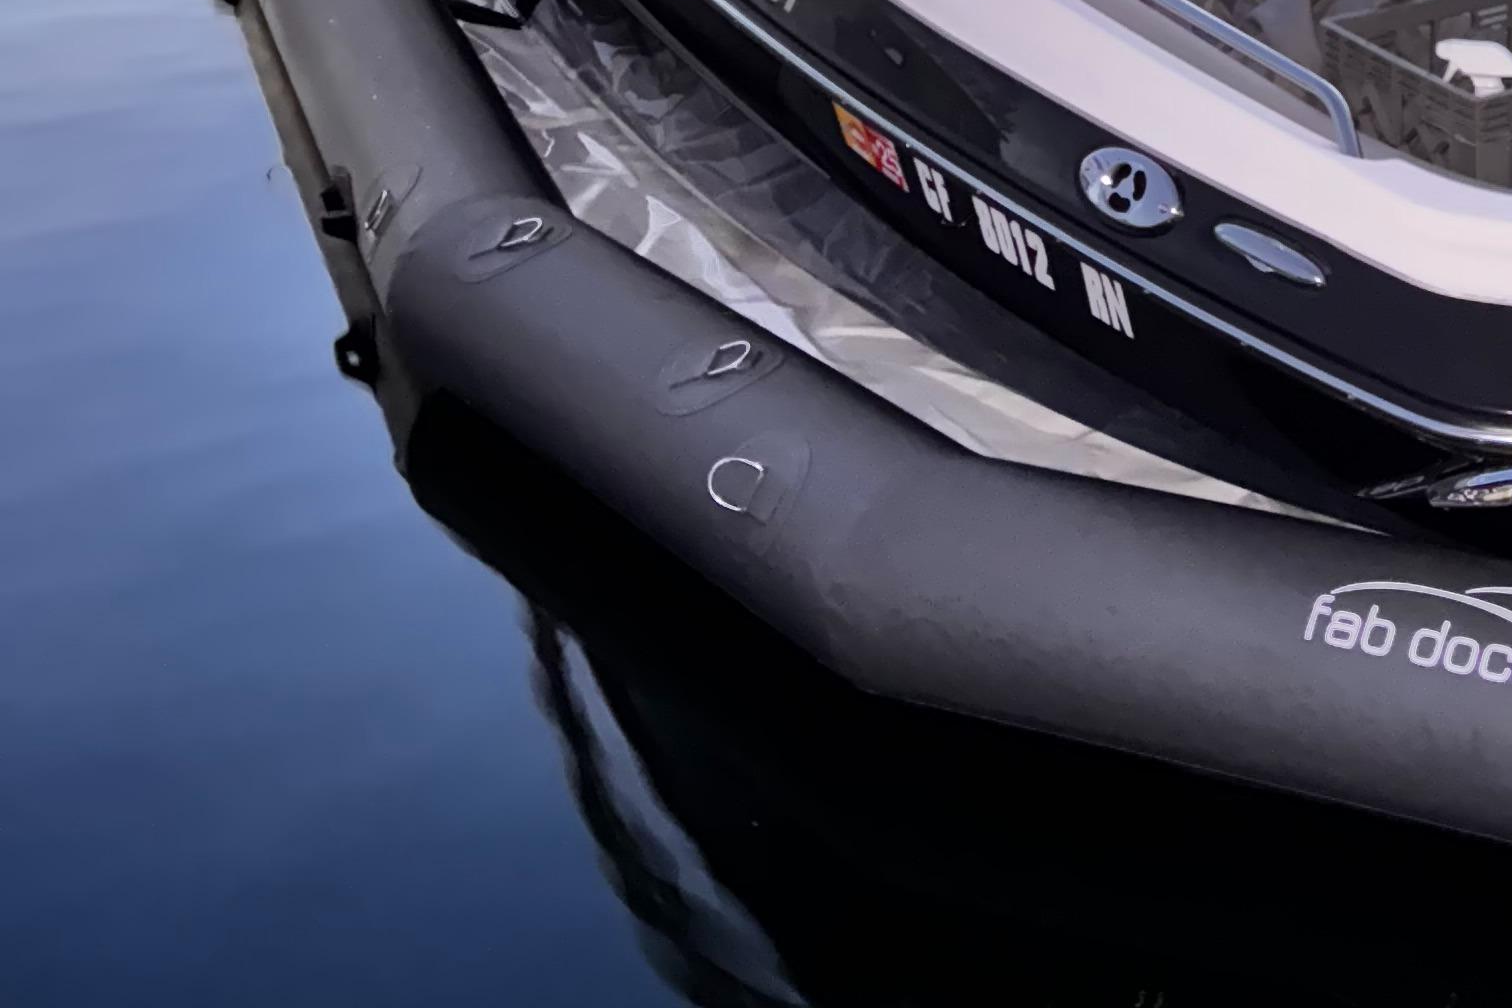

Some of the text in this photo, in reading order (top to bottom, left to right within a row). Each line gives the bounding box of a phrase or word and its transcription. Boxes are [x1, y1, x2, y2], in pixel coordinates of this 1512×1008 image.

[913, 157, 1135, 339] CF 8012 RN
[1303, 594, 1396, 657] fab
